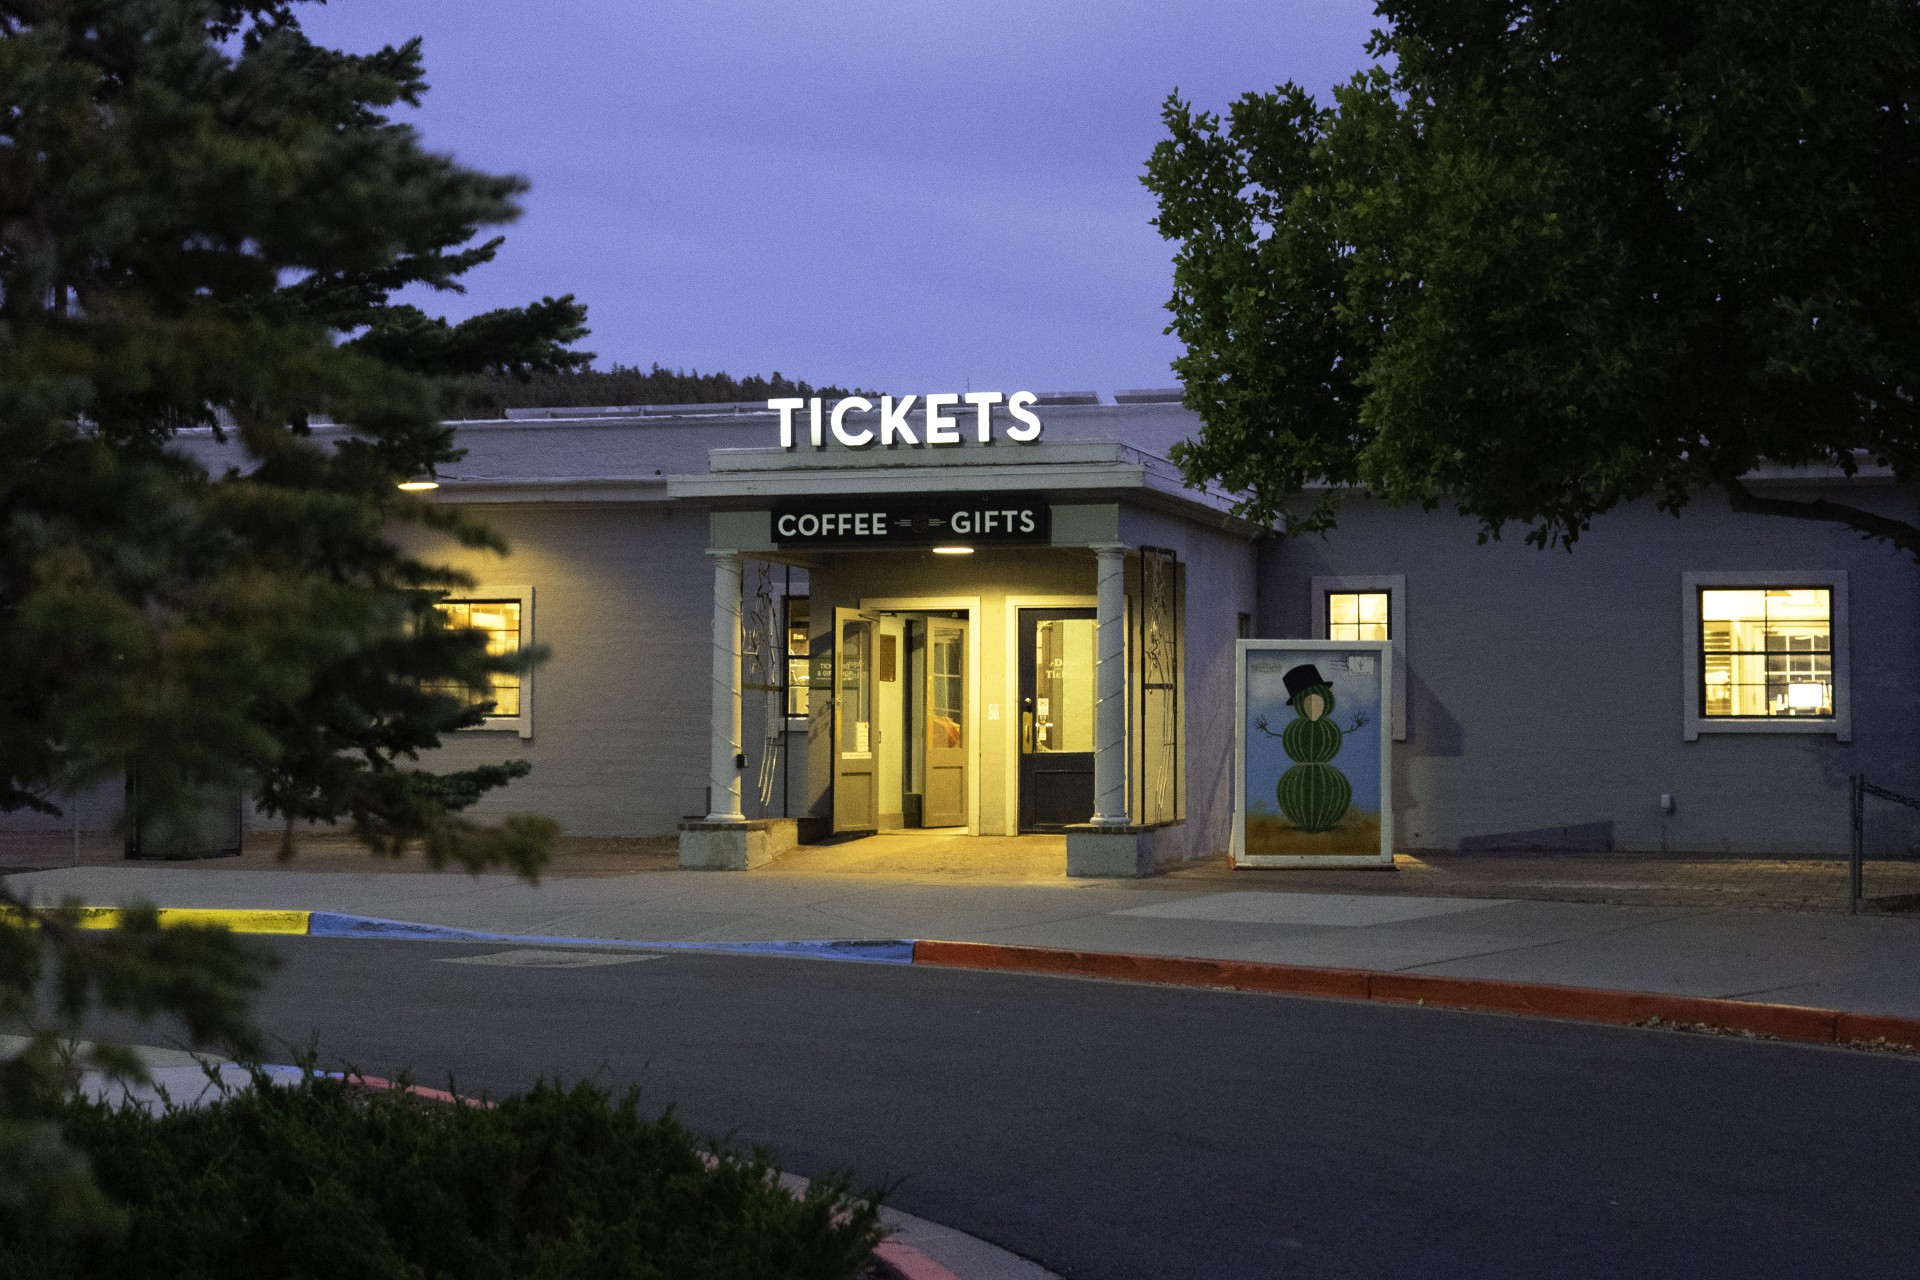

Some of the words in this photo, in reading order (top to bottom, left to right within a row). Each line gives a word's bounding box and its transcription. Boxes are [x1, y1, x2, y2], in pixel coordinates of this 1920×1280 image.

[768, 391, 1042, 448] TICKETS
[778, 513, 887, 536] COFFEE
[951, 510, 1035, 533] GIFTS
